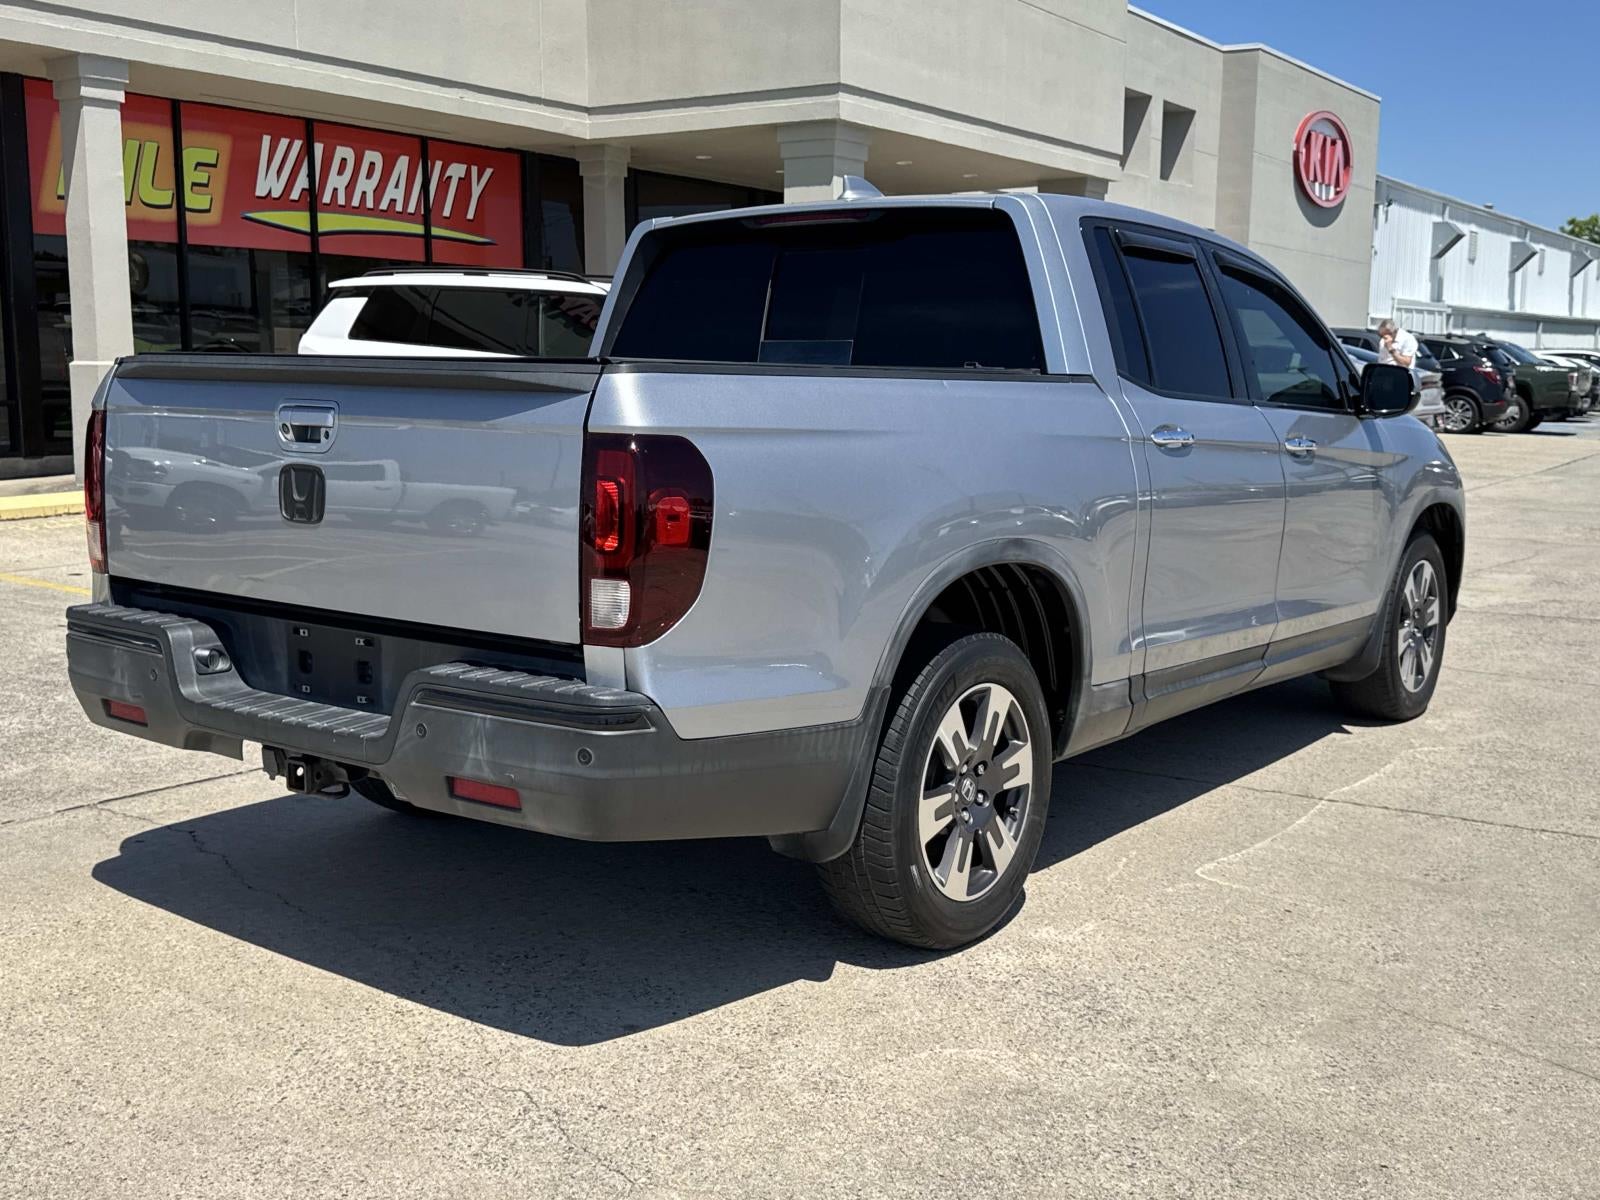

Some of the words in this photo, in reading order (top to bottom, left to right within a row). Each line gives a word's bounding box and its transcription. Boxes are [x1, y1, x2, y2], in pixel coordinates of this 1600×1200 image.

[56, 138, 220, 214] ILE
[254, 134, 494, 220] WARRANTY
[1308, 130, 1345, 192] KIA
